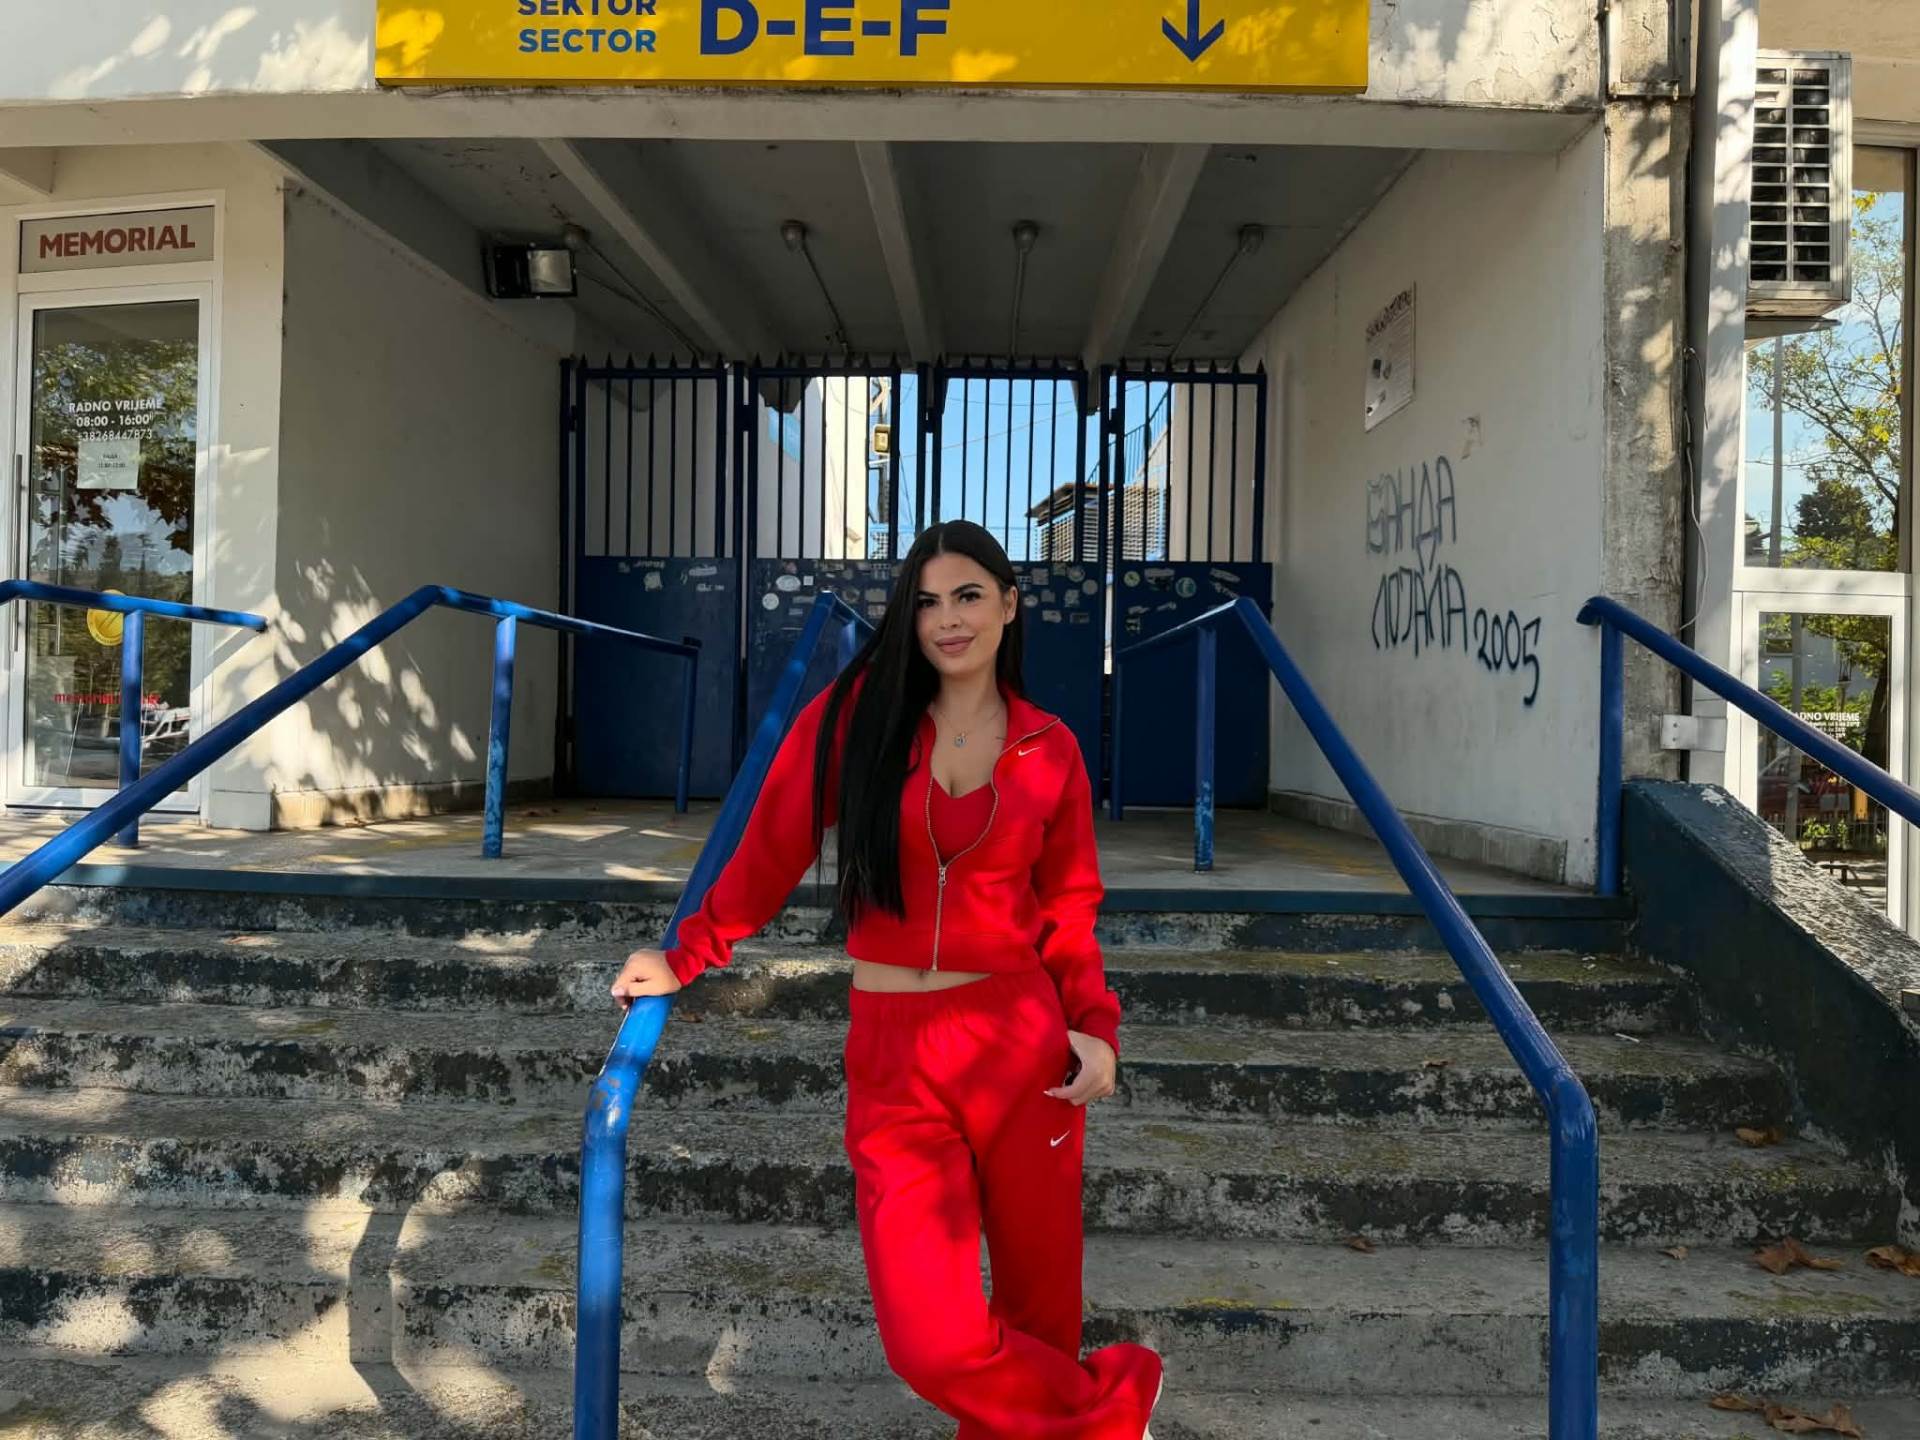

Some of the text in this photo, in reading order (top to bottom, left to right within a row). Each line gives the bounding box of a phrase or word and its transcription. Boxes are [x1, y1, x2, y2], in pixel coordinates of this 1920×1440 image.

[518, 0, 656, 16] SEKTOR
[518, 28, 656, 53] SECTOR
[700, 0, 951, 56] D-E-F
[39, 224, 195, 259] MEMORIAL
[68, 397, 162, 413] RADNO VRIJEME
[76, 415, 108, 427] 08:00
[1474, 608, 1542, 707] 2005
